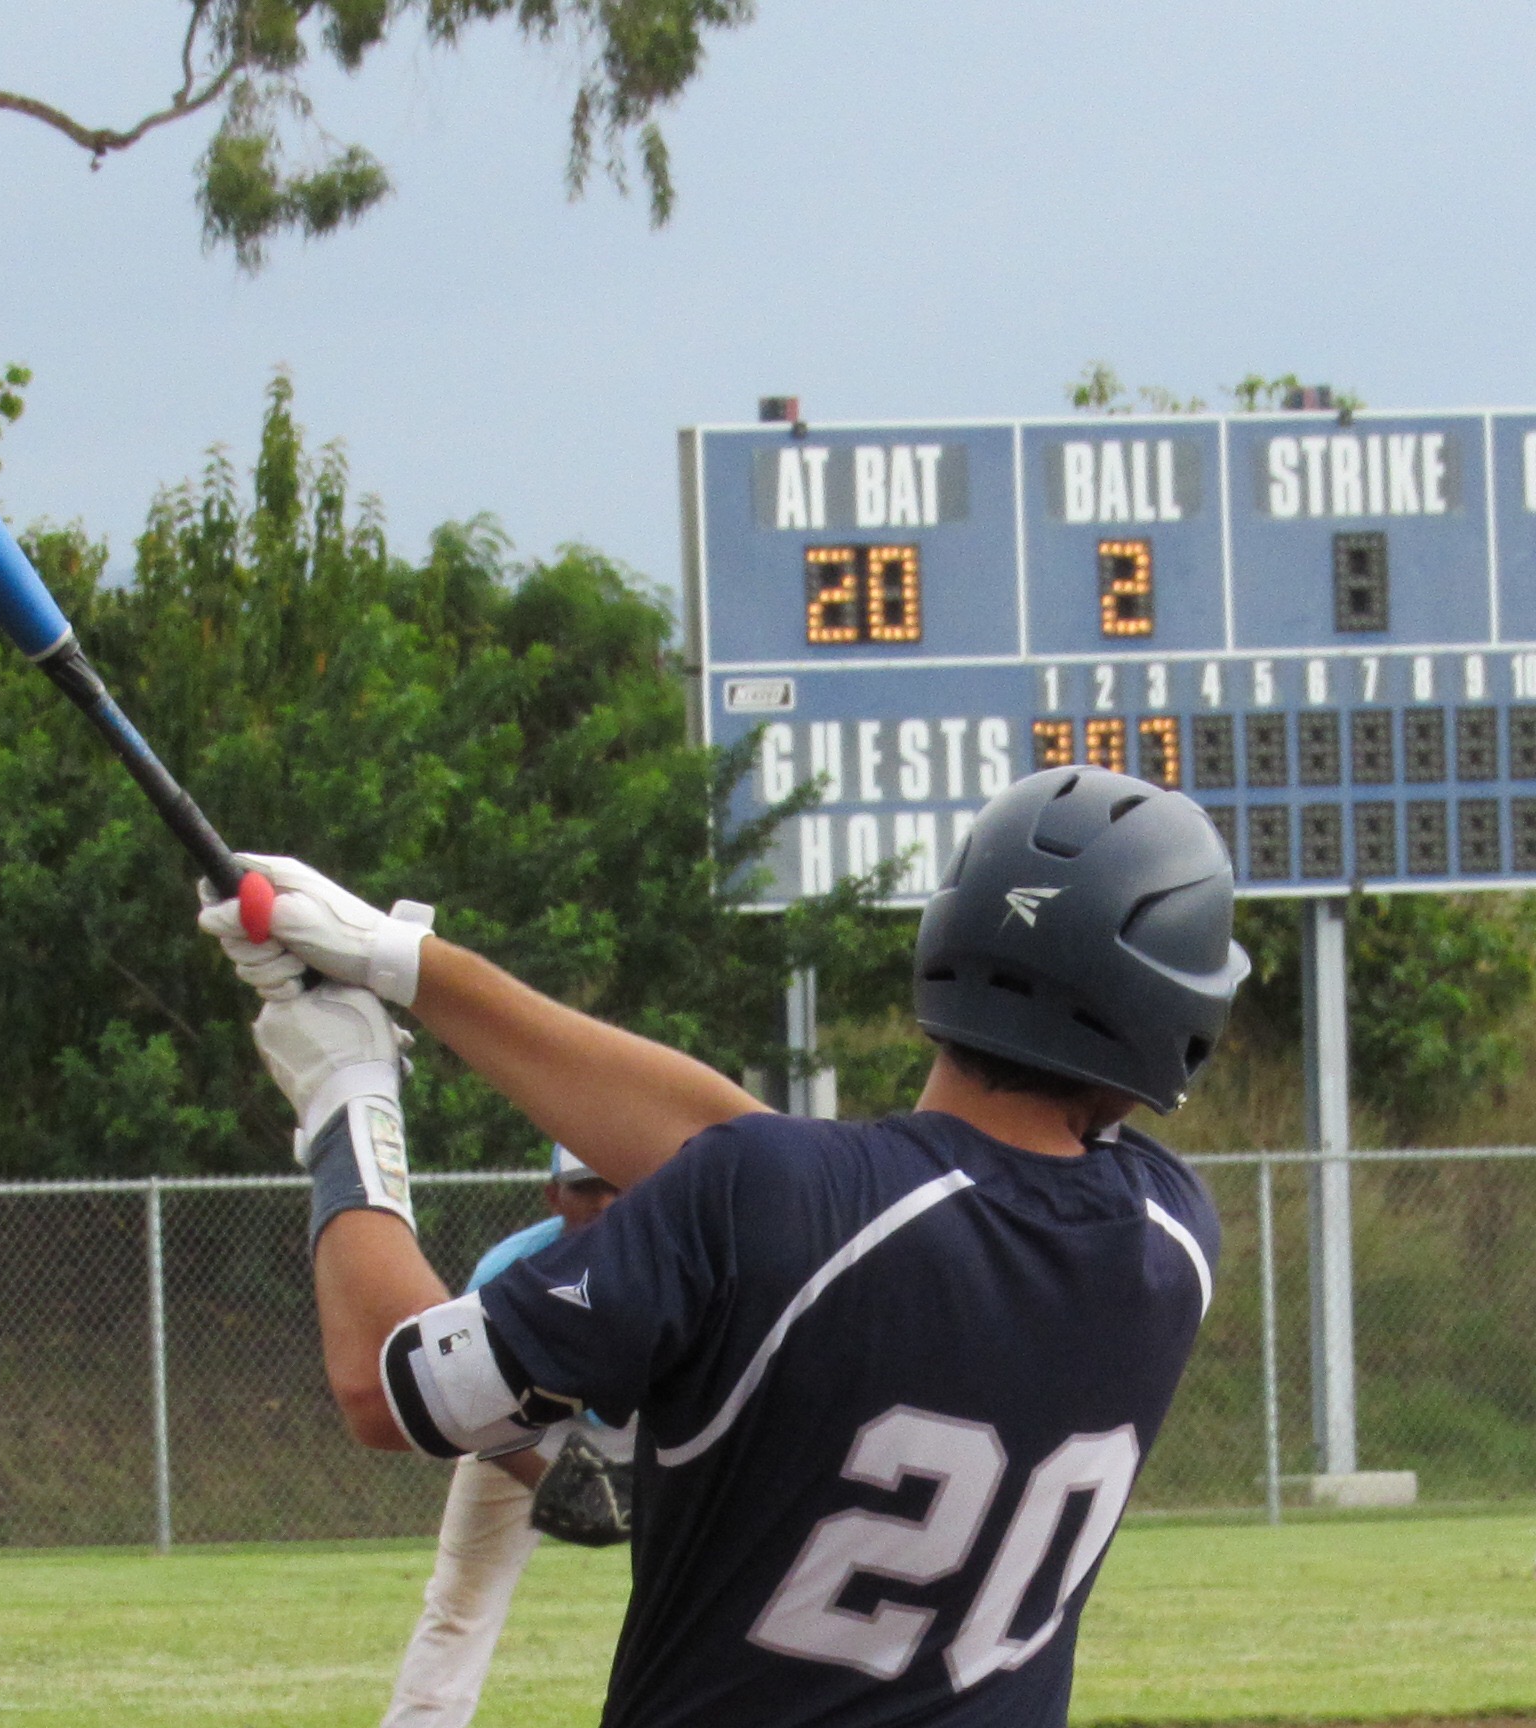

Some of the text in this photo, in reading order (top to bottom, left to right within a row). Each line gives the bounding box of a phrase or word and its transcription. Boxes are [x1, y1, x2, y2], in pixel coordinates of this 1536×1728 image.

[776, 445, 943, 529] AT BAT
[1064, 440, 1181, 521] BALL
[1268, 432, 1447, 517] STRIKE
[805, 545, 921, 643] 20
[1099, 539, 1152, 636] 2
[1044, 666, 1058, 712] 1
[1095, 664, 1114, 711] 2
[1148, 663, 1168, 709] 3
[1201, 661, 1221, 708] 4
[1254, 660, 1273, 706] 5
[1308, 658, 1326, 704] 6
[1362, 656, 1379, 701] 7
[1415, 656, 1432, 700] 8
[1466, 654, 1484, 699] 9
[762, 716, 1012, 804] GUESTS
[745, 1402, 1142, 1694] 20
